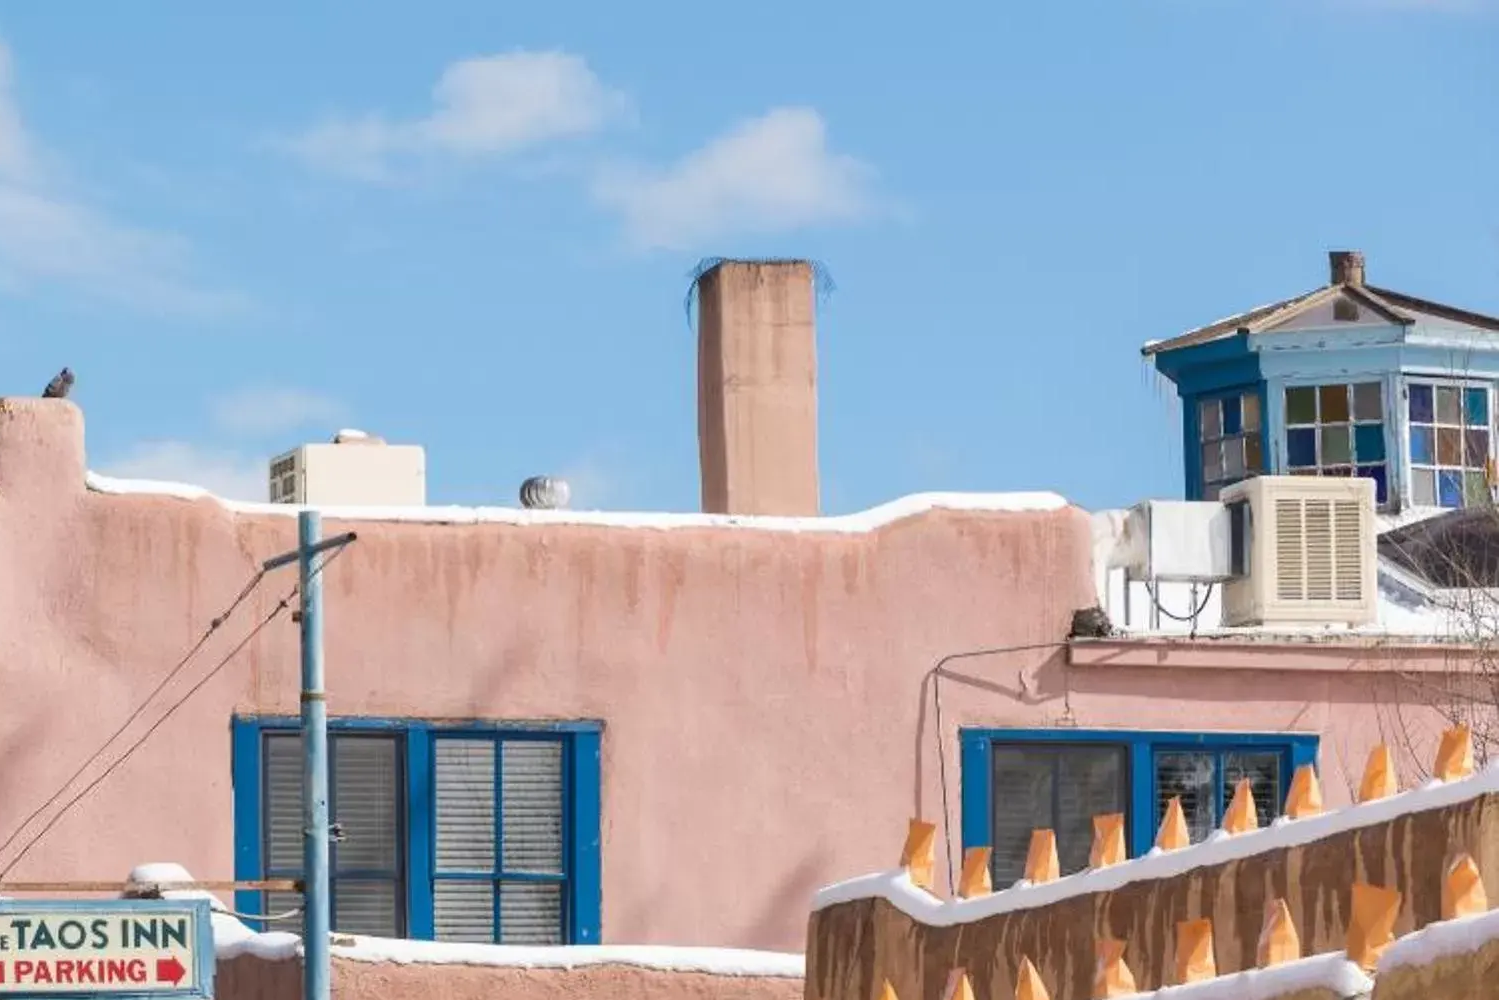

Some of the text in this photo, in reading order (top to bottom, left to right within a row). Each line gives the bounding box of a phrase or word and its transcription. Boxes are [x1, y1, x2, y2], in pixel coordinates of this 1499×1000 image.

[10, 919, 110, 950] TAOS
[121, 918, 187, 949] INN
[13, 958, 148, 984] PARKING
